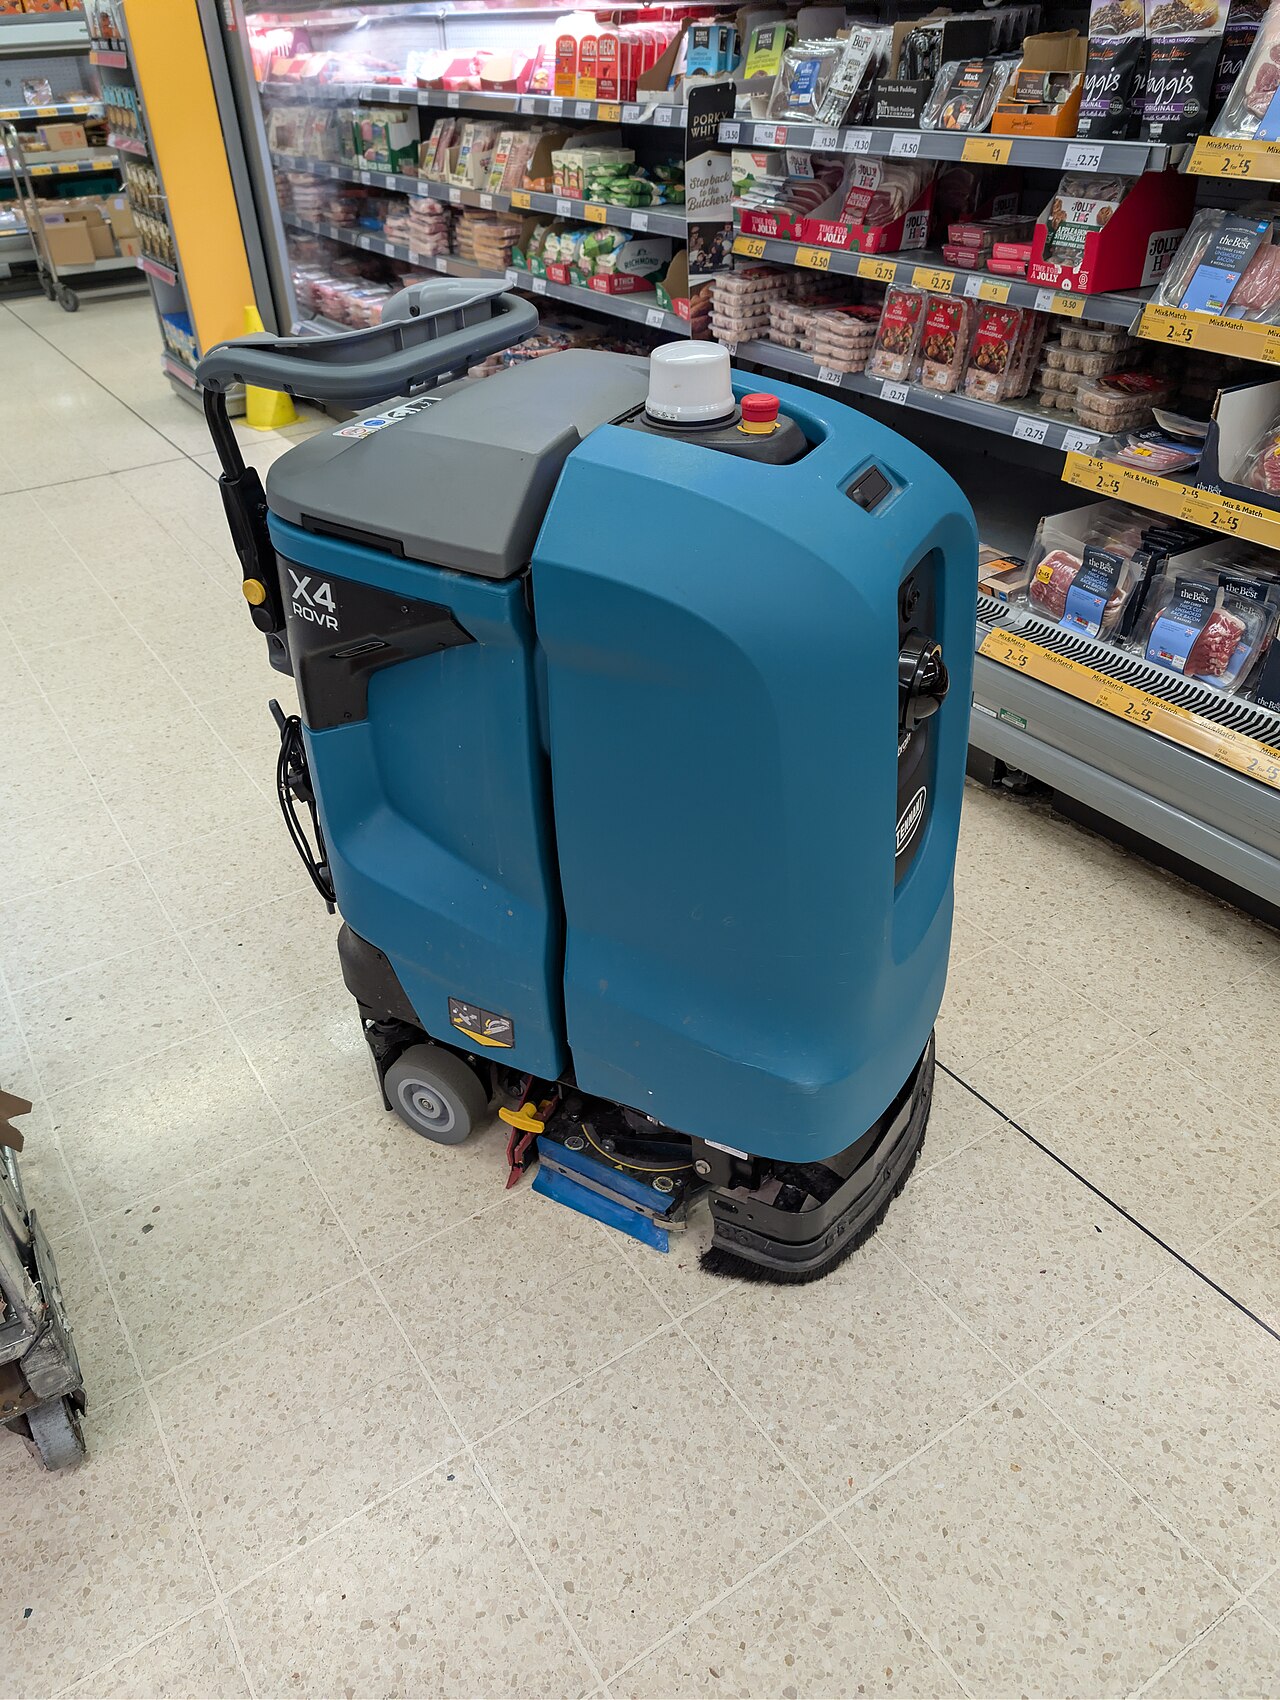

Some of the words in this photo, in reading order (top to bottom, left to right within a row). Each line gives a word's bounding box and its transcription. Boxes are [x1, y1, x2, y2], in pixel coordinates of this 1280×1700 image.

[887, 85, 899, 93] Black
[900, 86, 917, 94] Pudding
[958, 80, 980, 88] Pudding
[691, 123, 719, 138] WHIT
[725, 130, 738, 140] £3.50
[822, 137, 836, 147] £1.30
[854, 139, 869, 150] £1.30
[901, 142, 917, 154] £1.50
[1206, 141, 1243, 151] Mix&Match
[992, 149, 1000, 161] £1
[1077, 154, 1099, 167] £2.75
[860, 164, 877, 176] JOLLY
[1221, 158, 1230, 171] 2
[1239, 159, 1252, 173] £5
[689, 174, 710, 190] Step
[709, 171, 730, 184] back
[700, 188, 709, 198] to
[708, 186, 719, 196] the
[1071, 201, 1097, 213] JOLLY
[751, 216, 764, 225] TIME
[765, 218, 777, 226] FOR
[905, 214, 928, 227] JOLLY
[1072, 212, 1090, 223] HOG
[757, 224, 778, 235] JOLLY
[819, 224, 833, 233] TIME
[834, 226, 848, 235] FOR
[816, 233, 823, 241] A
[823, 233, 847, 245] JOLLY
[747, 244, 763, 255] £2.50
[1214, 250, 1243, 260] UNSMOKED
[624, 258, 659, 269] RICHMOND
[810, 255, 828, 267] £2.50
[874, 267, 893, 280] £2.75
[1033, 263, 1046, 272] TIME
[1046, 266, 1059, 274] FOR
[619, 277, 635, 286] THICK
[1030, 271, 1036, 279] A
[1036, 271, 1059, 283] JOLLY
[931, 278, 951, 291] £2.75
[1062, 299, 1076, 309] £3.50
[1154, 308, 1187, 321] Mix&Match
[926, 320, 951, 330] SAUSAGEMEAT
[986, 324, 998, 332] PORK
[1208, 317, 1244, 331] Mix&Match
[977, 328, 1003, 339] SAUSAGEMEAT
[1166, 325, 1175, 338] 2
[1182, 327, 1194, 341] £5
[827, 372, 841, 383] £2.75
[890, 390, 905, 401] £2.75
[1025, 427, 1044, 440] £2.75
[1088, 459, 1093, 467] 2
[1097, 461, 1104, 470] £5
[1096, 476, 1104, 488] 2
[1110, 480, 1120, 492] £5
[1123, 470, 1134, 479] Mix
[1141, 476, 1159, 487] Match
[1181, 487, 1187, 495] 2
[1191, 490, 1199, 498] £5
[1222, 500, 1234, 510] Mix
[1242, 506, 1263, 518] Match
[1211, 511, 1219, 524] 2
[1227, 516, 1239, 530] £5
[1083, 574, 1108, 587] UNSMOKED
[1100, 574, 1109, 582] CUT
[288, 569, 336, 613] X4
[1093, 582, 1107, 592] BACON
[1174, 606, 1202, 618] UNSMOKED
[1179, 602, 1193, 611] THICK
[291, 601, 339, 632] ROVR
[1186, 614, 1201, 623] BACON
[998, 632, 1026, 649] Mix&Match
[1004, 649, 1013, 660] 2
[1018, 654, 1029, 667] £5
[1043, 652, 1073, 670] Mix&Match
[1091, 673, 1124, 692] Mix&Match
[1123, 702, 1135, 715] 2
[1132, 708, 1140, 716] for
[1140, 708, 1153, 722] £5
[1144, 696, 1178, 716] Mix&Match
[1200, 721, 1237, 741] Mix&Match
[1247, 757, 1259, 771] 2
[1266, 765, 1280, 780] £5
